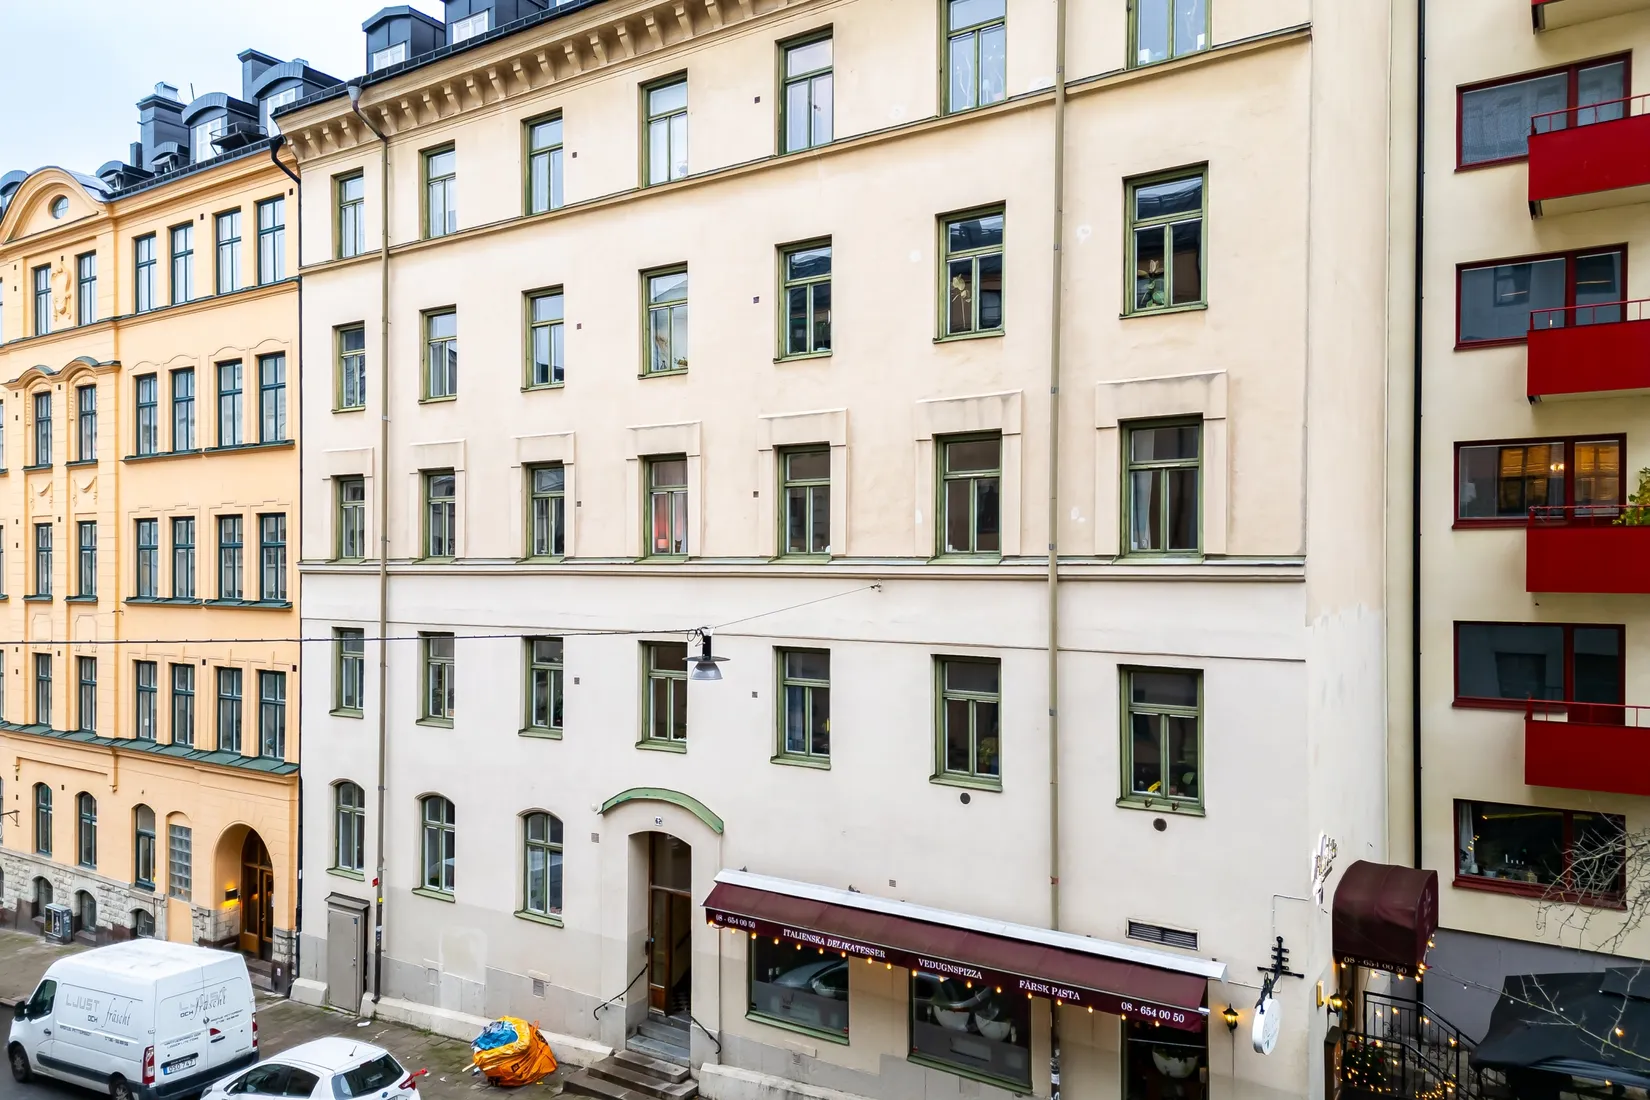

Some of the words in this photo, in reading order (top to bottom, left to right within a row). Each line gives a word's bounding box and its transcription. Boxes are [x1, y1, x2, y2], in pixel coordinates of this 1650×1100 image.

[727, 916, 739, 925] 654
[748, 921, 756, 929] 50
[783, 928, 825, 945] ITALIENSKA
[827, 938, 886, 958] DELIKATESSER
[918, 958, 983, 979] VEDUGNSPIZZA
[1363, 960, 1379, 968] 654
[1396, 966, 1407, 974] 50
[1019, 980, 1049, 994] FÄRSK
[1052, 987, 1080, 1001] PASTA
[66, 994, 100, 1012] LJUST
[1121, 1002, 1132, 1012] 08
[1140, 1006, 1156, 1018] 654
[1159, 1010, 1170, 1020] 00
[1173, 1012, 1185, 1023] 50
[88, 1015, 98, 1023] OCH
